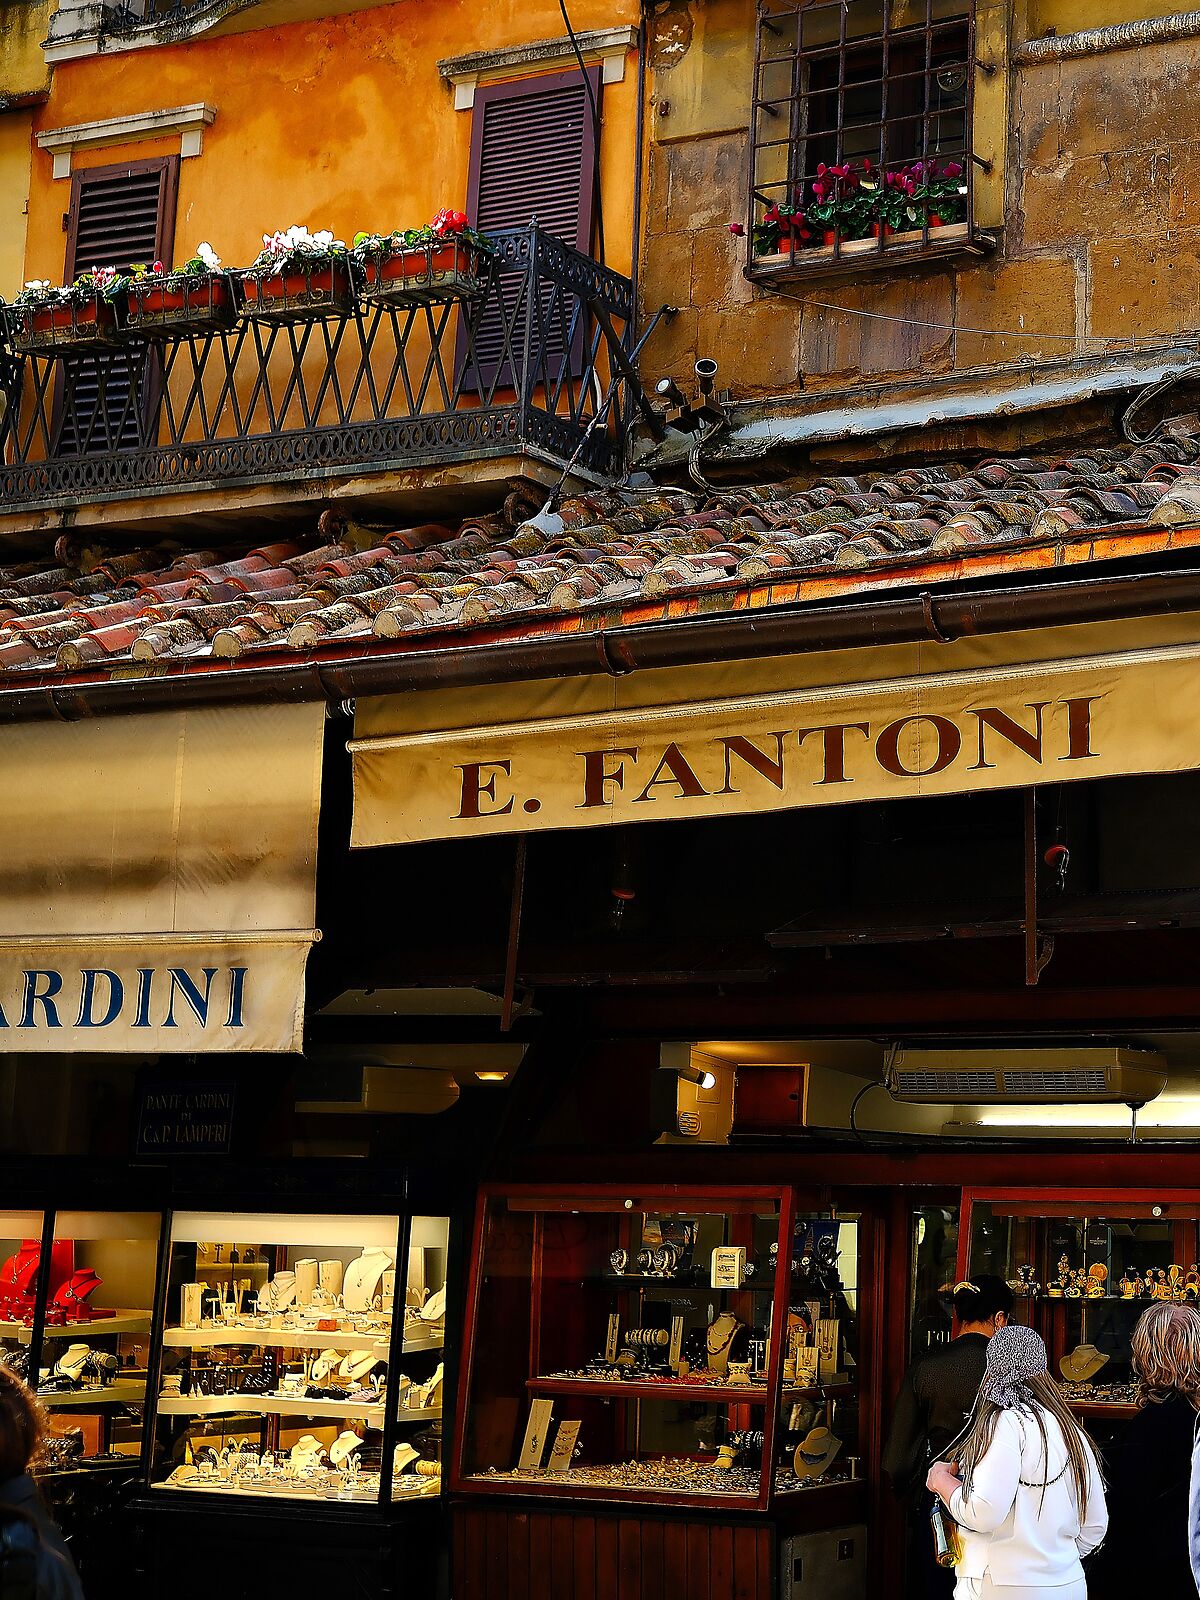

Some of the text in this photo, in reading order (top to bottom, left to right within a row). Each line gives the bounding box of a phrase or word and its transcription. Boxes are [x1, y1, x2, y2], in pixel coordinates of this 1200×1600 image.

[450, 695, 1103, 820] E. FANTONI
[0, 967, 249, 1028] RDINI
[146, 1093, 231, 1111] DANTE CARDINI
